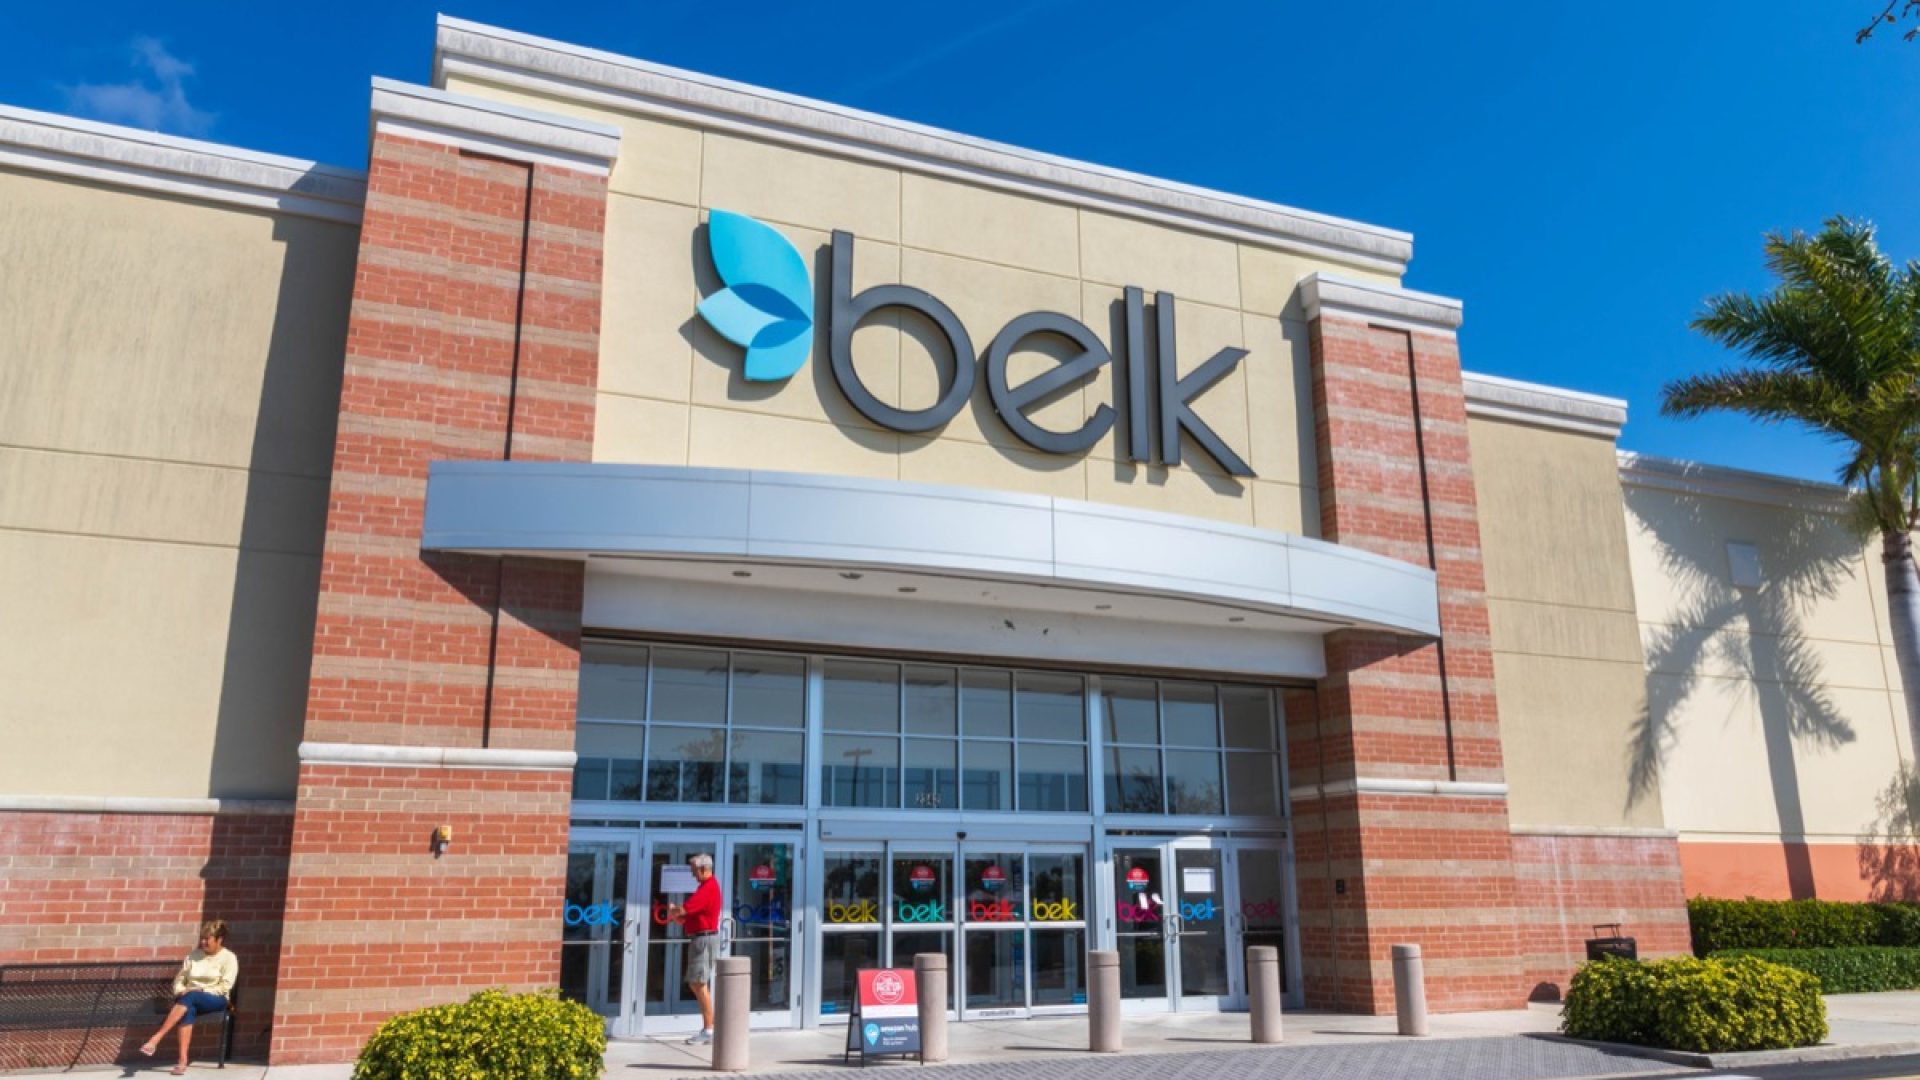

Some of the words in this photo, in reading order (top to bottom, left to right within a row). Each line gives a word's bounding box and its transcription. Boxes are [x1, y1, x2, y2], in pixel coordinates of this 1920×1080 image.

[830, 229, 1257, 477] belk
[564, 899, 619, 926] belk
[829, 898, 877, 922] belk
[899, 898, 944, 922] belk
[972, 898, 1016, 922] belk
[1033, 897, 1076, 920] belk
